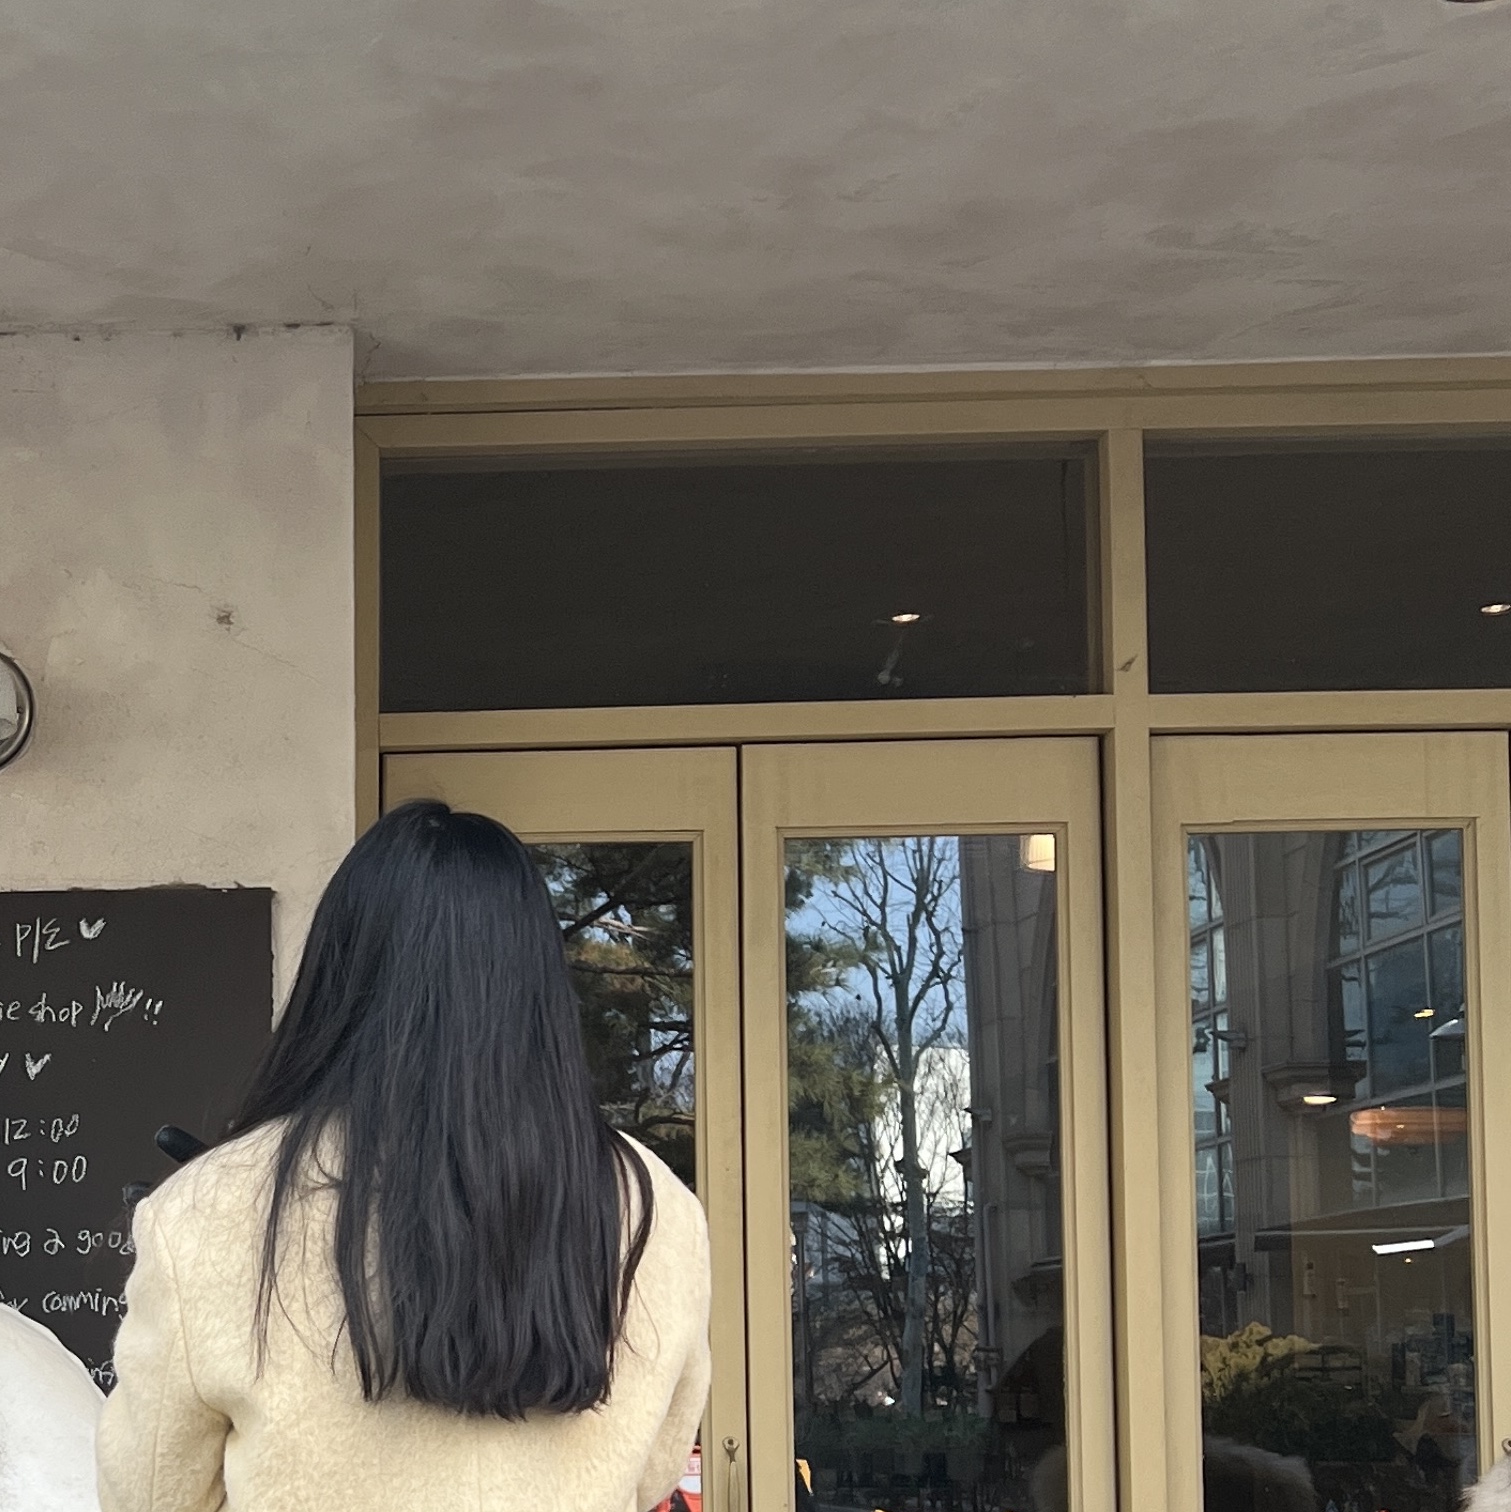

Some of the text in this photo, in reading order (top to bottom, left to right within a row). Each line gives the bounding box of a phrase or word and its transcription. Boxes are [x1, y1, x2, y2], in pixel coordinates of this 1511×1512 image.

[16, 917, 70, 963] PIE
[28, 993, 83, 1027] shop
[44, 1228, 65, 1255] a
